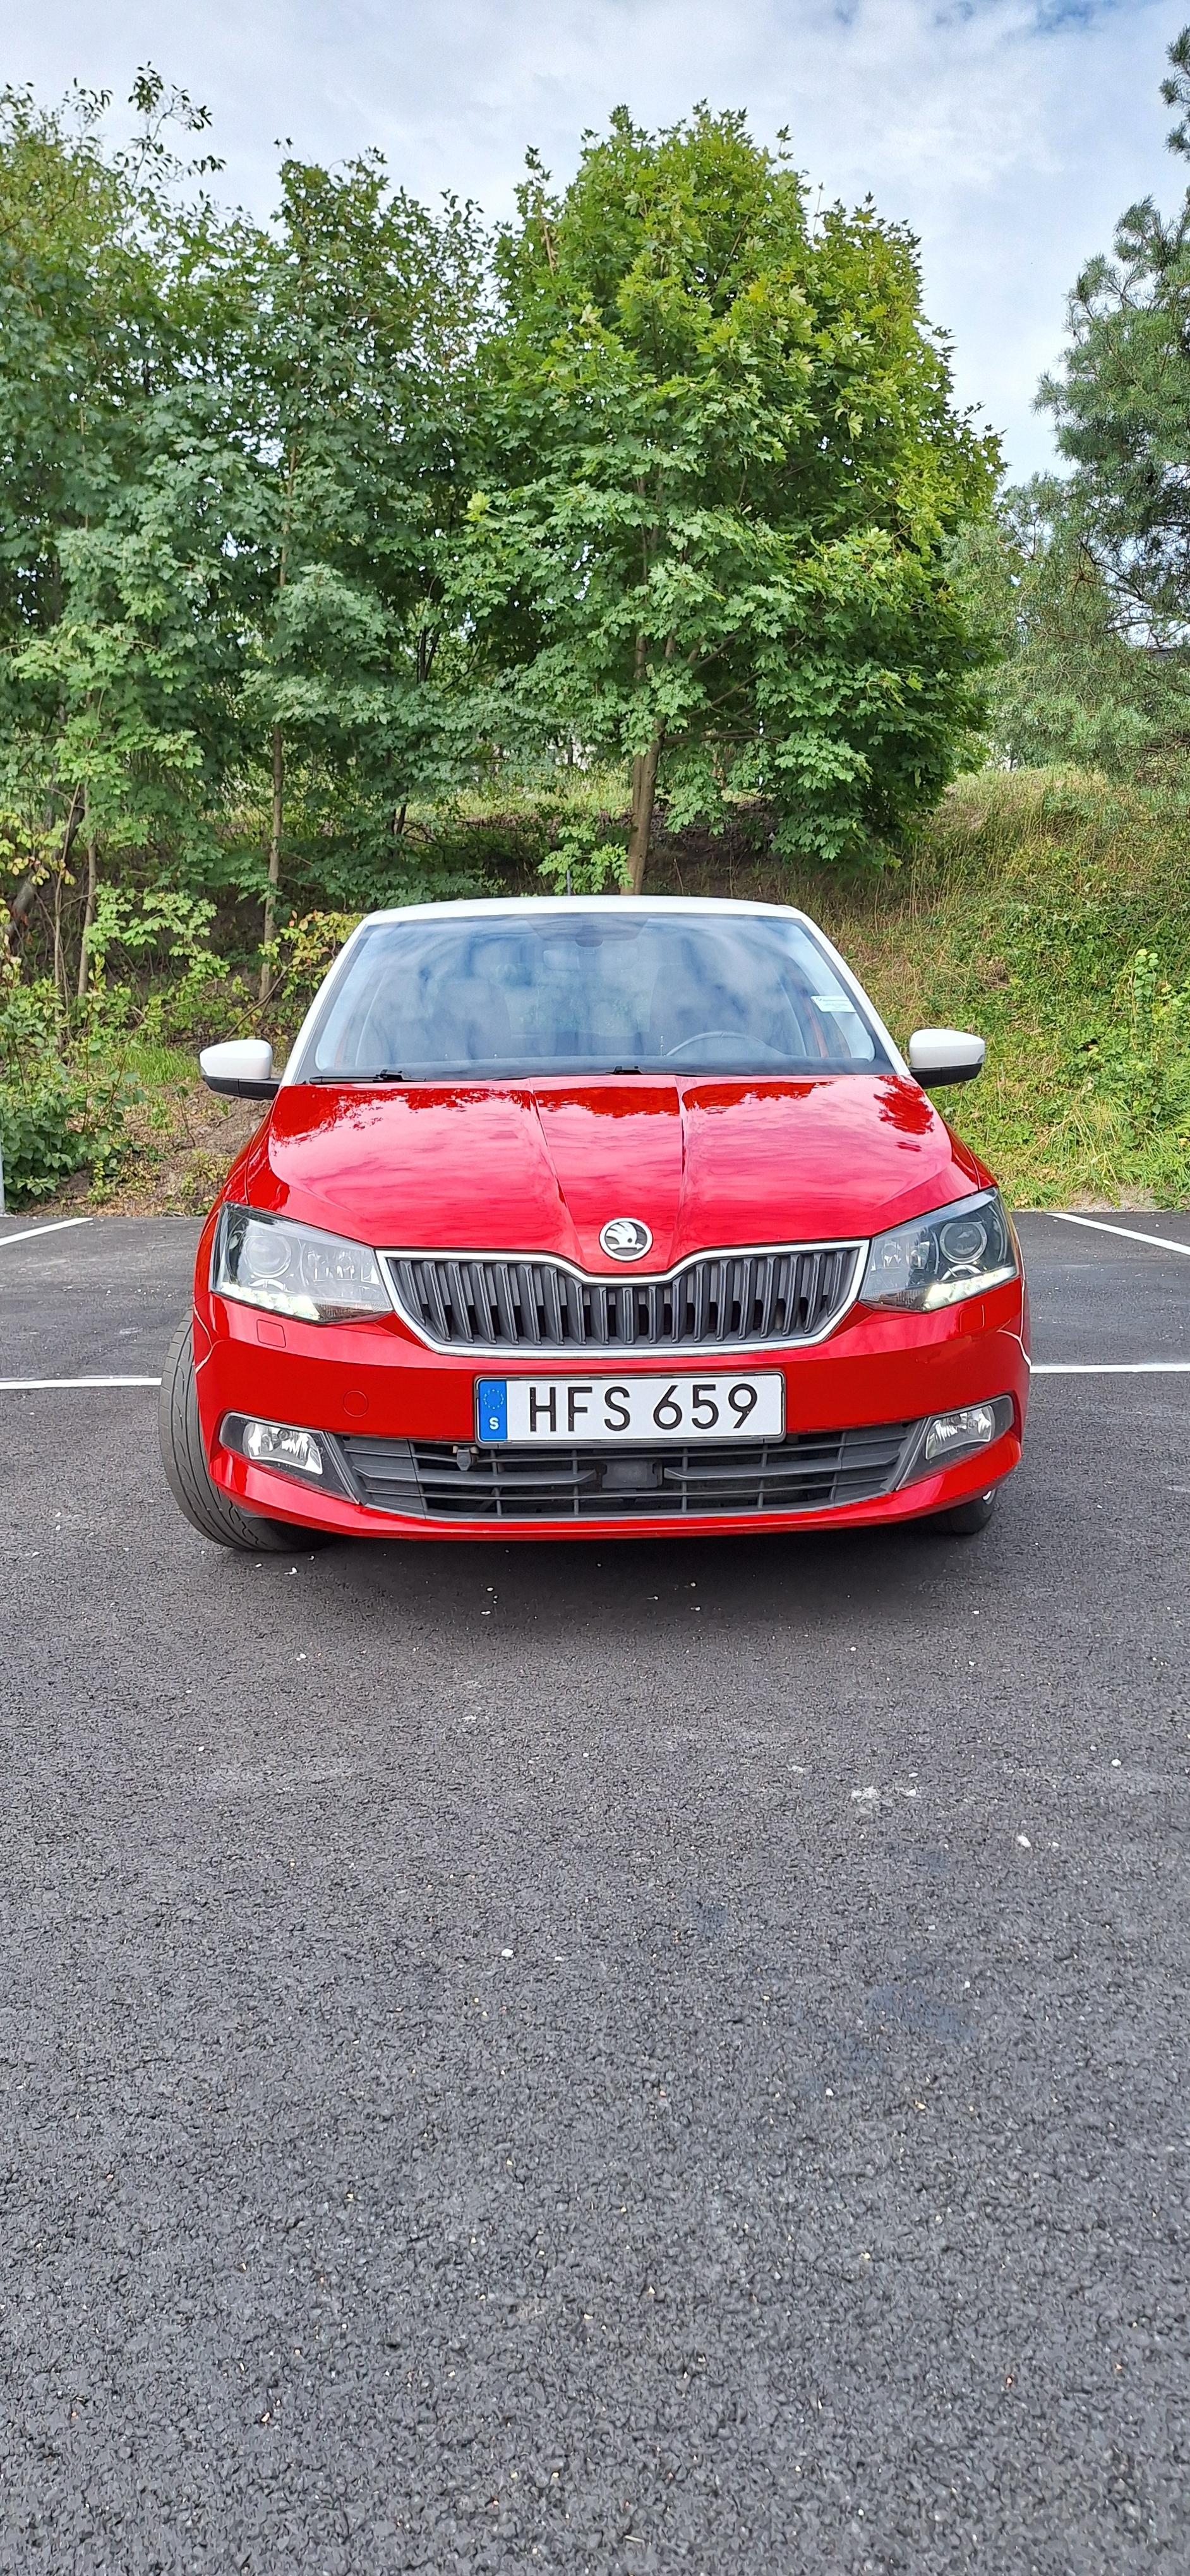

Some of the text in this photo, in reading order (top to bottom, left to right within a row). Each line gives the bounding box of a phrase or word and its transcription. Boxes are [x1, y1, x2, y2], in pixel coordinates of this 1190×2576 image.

[529, 1383, 758, 1432] HFS 659
[489, 1417, 499, 1430] S
